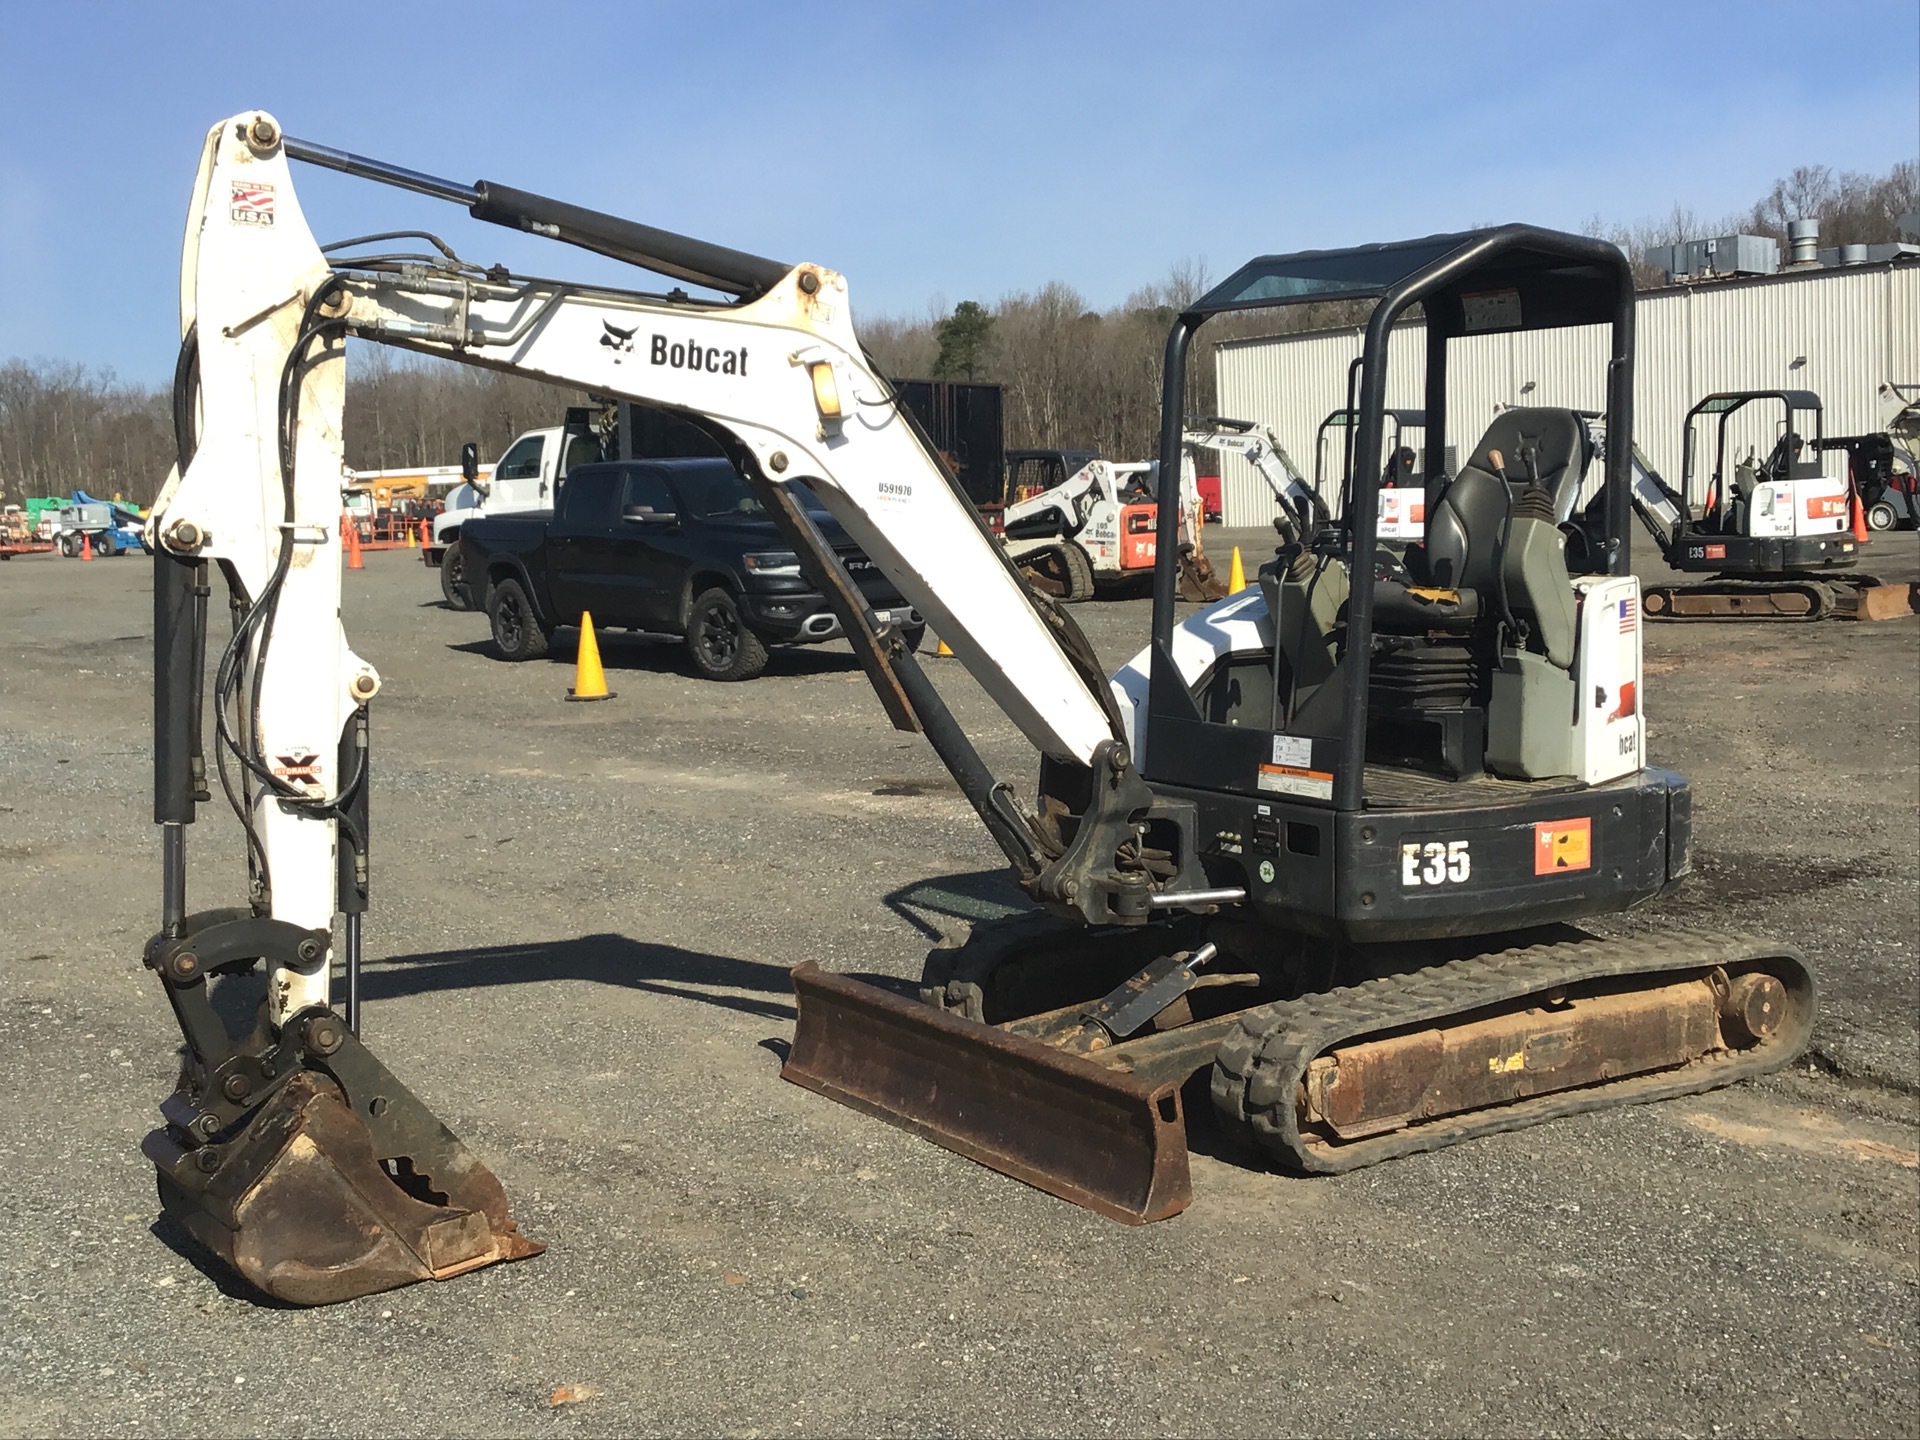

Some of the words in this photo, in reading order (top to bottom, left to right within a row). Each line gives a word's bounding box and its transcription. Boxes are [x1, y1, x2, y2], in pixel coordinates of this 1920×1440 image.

[233, 209, 272, 224] USA
[651, 334, 748, 377] Bobcat
[878, 482, 912, 496] U591970
[1688, 546, 1704, 559] E35
[848, 561, 876, 570] RA
[275, 766, 321, 775] HYDRAULIC
[1402, 840, 1471, 886] E35
